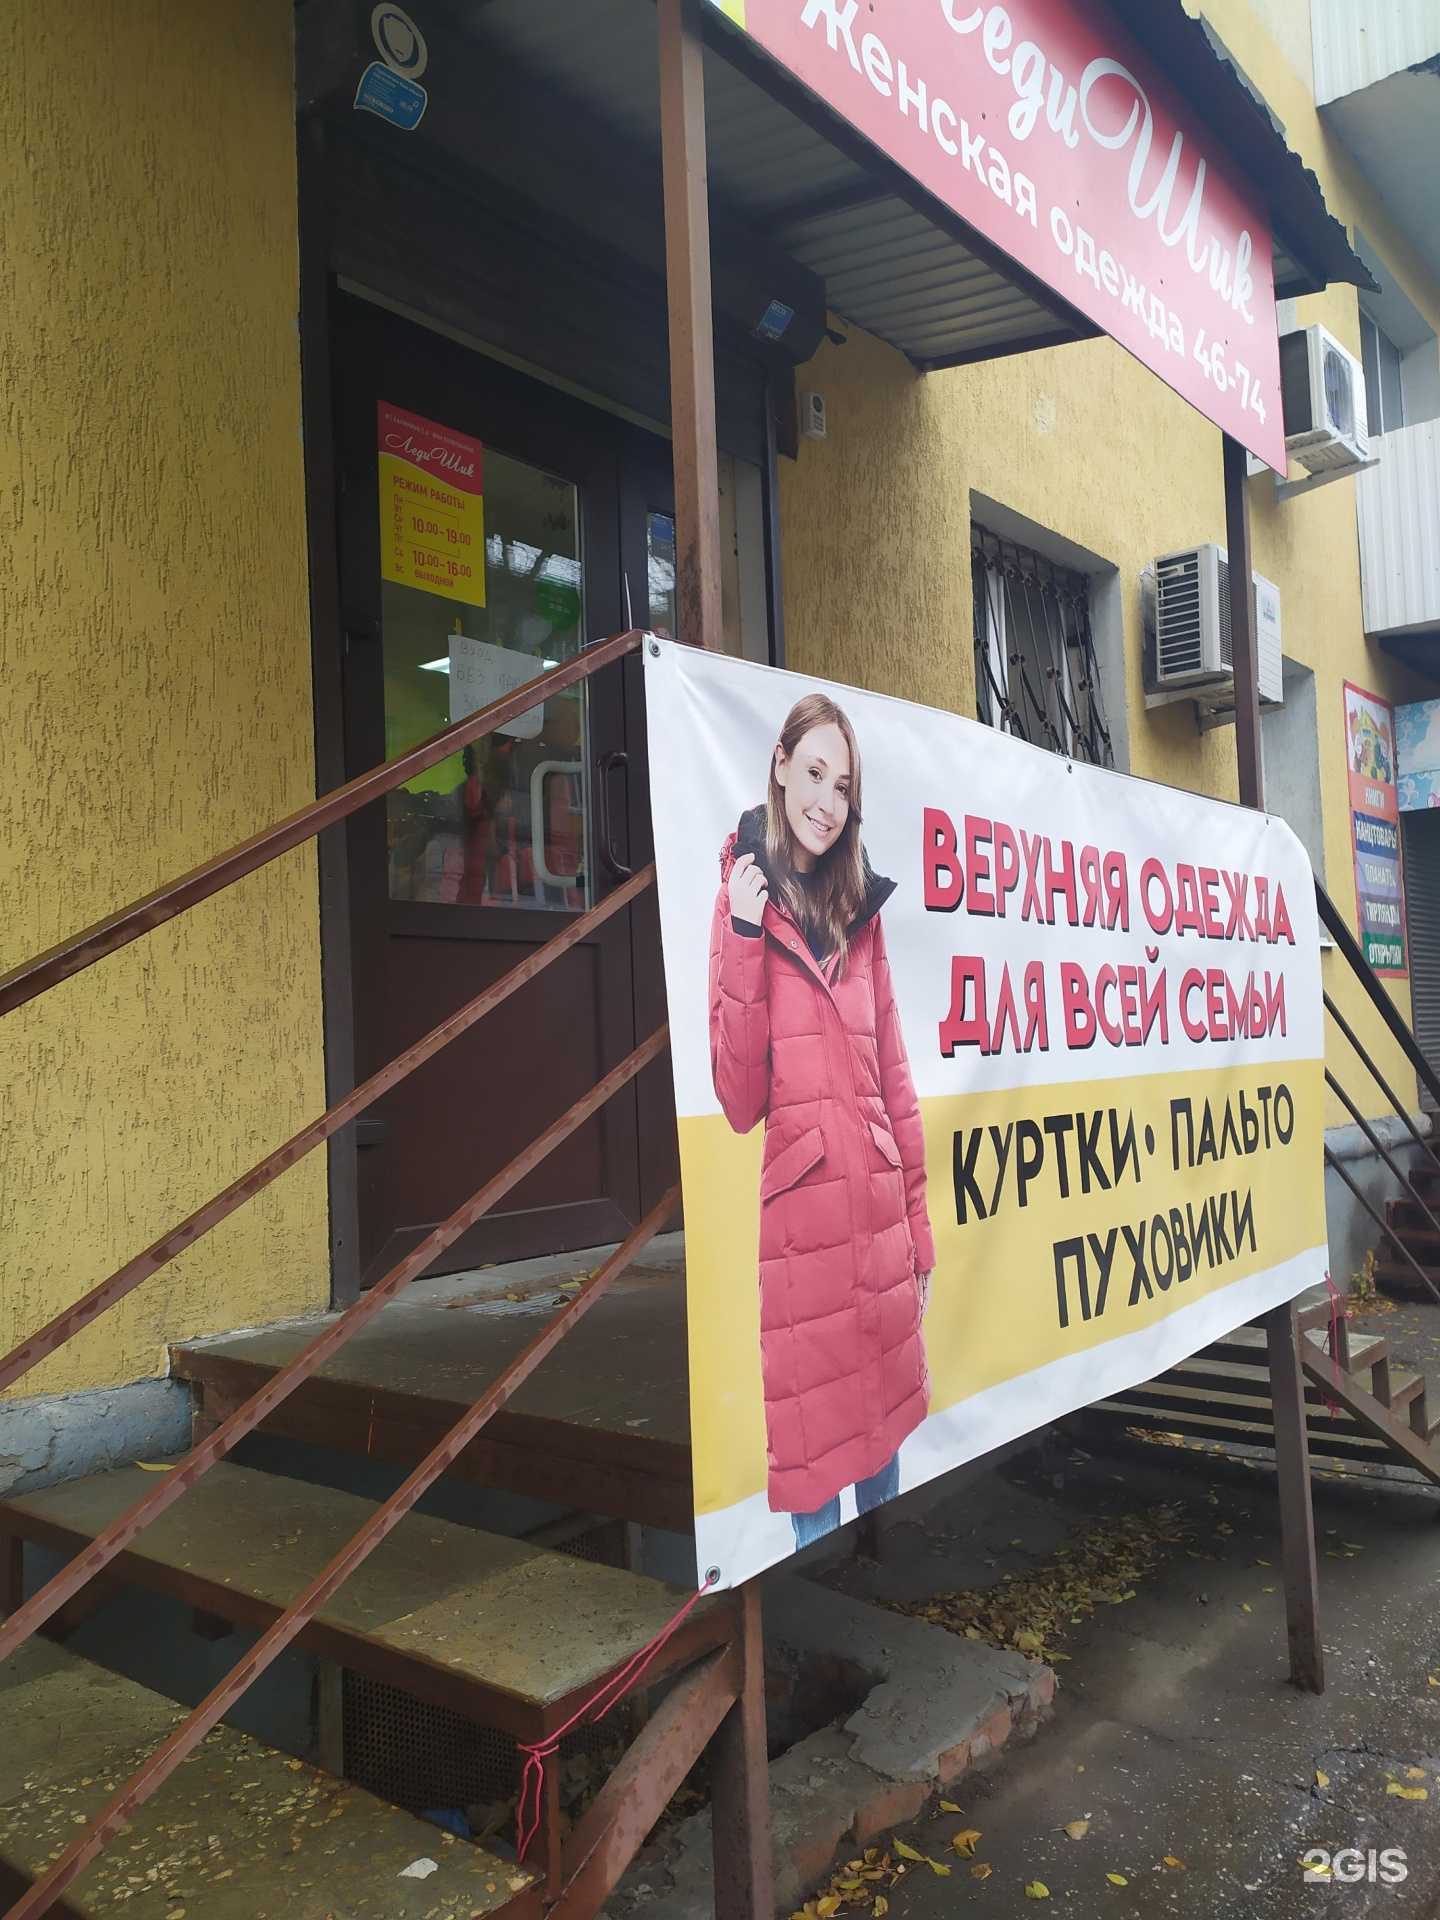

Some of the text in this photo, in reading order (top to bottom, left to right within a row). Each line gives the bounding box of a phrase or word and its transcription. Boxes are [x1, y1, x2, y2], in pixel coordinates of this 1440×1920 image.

[800, 0, 1268, 425] Женская одежда 46-74
[939, 0, 1256, 324] еди Шик
[393, 475, 465, 511] РЕЖИМ РАБОТЫ
[922, 807, 1297, 946] ВЕРХНЯЯ ОДЕЖДА
[938, 945, 1288, 1059] ДЛЯ ВСЕЙ СЕМЬИ
[1170, 1083, 1295, 1171] ПАЛЬТО
[1052, 1186, 1258, 1329] ПУХОВИКИ
